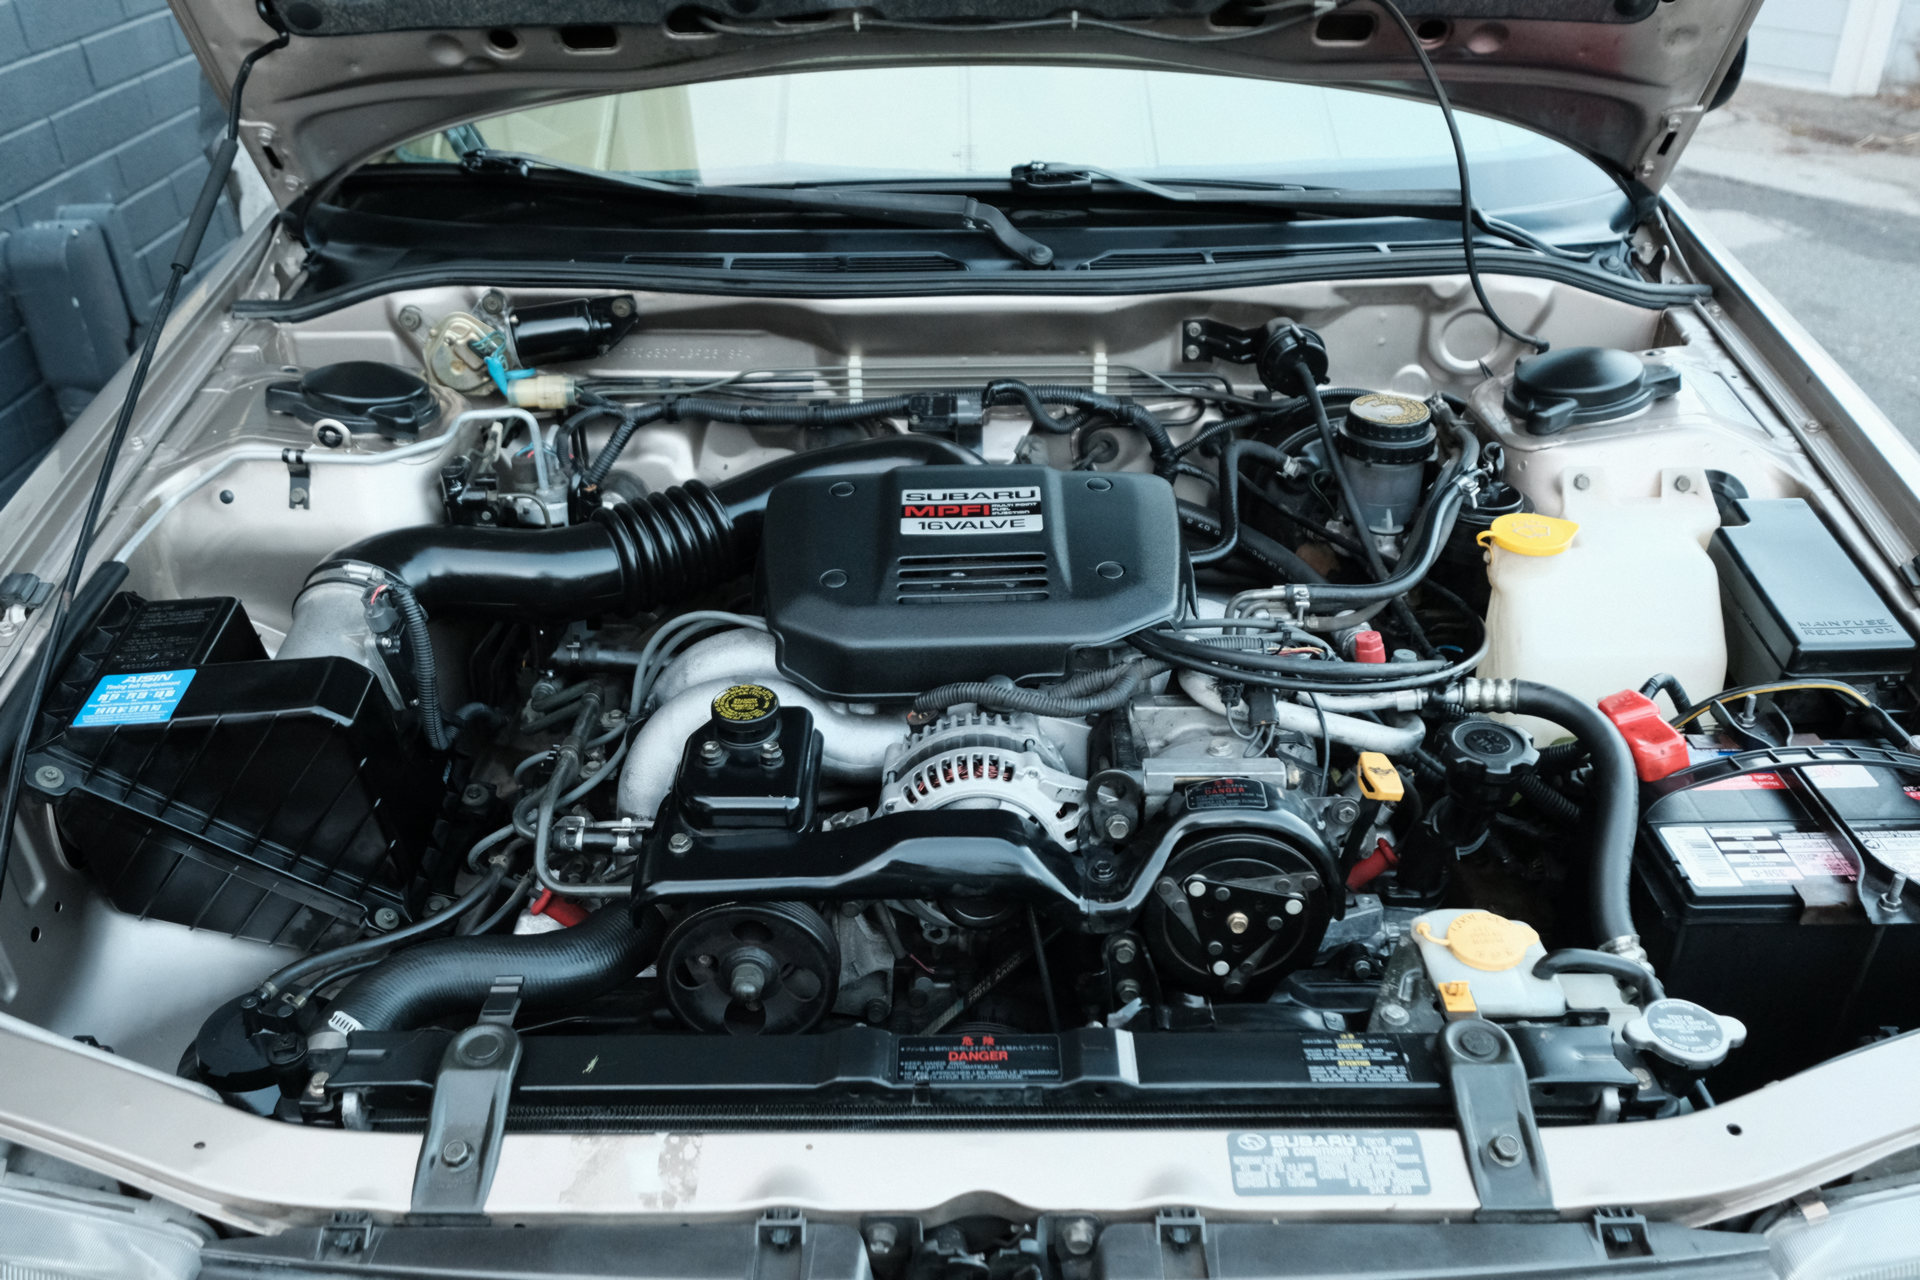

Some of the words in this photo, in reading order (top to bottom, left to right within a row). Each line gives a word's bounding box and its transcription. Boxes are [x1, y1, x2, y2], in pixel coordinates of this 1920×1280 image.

[906, 490, 1036, 502] SUBARU
[904, 504, 990, 517] MPFI
[918, 518, 1026, 530] 16VALVE
[121, 673, 174, 684] AISIN
[1204, 787, 1245, 795] DANGER
[948, 1050, 1008, 1061] DANGER
[1269, 1135, 1358, 1147] SUBARU
